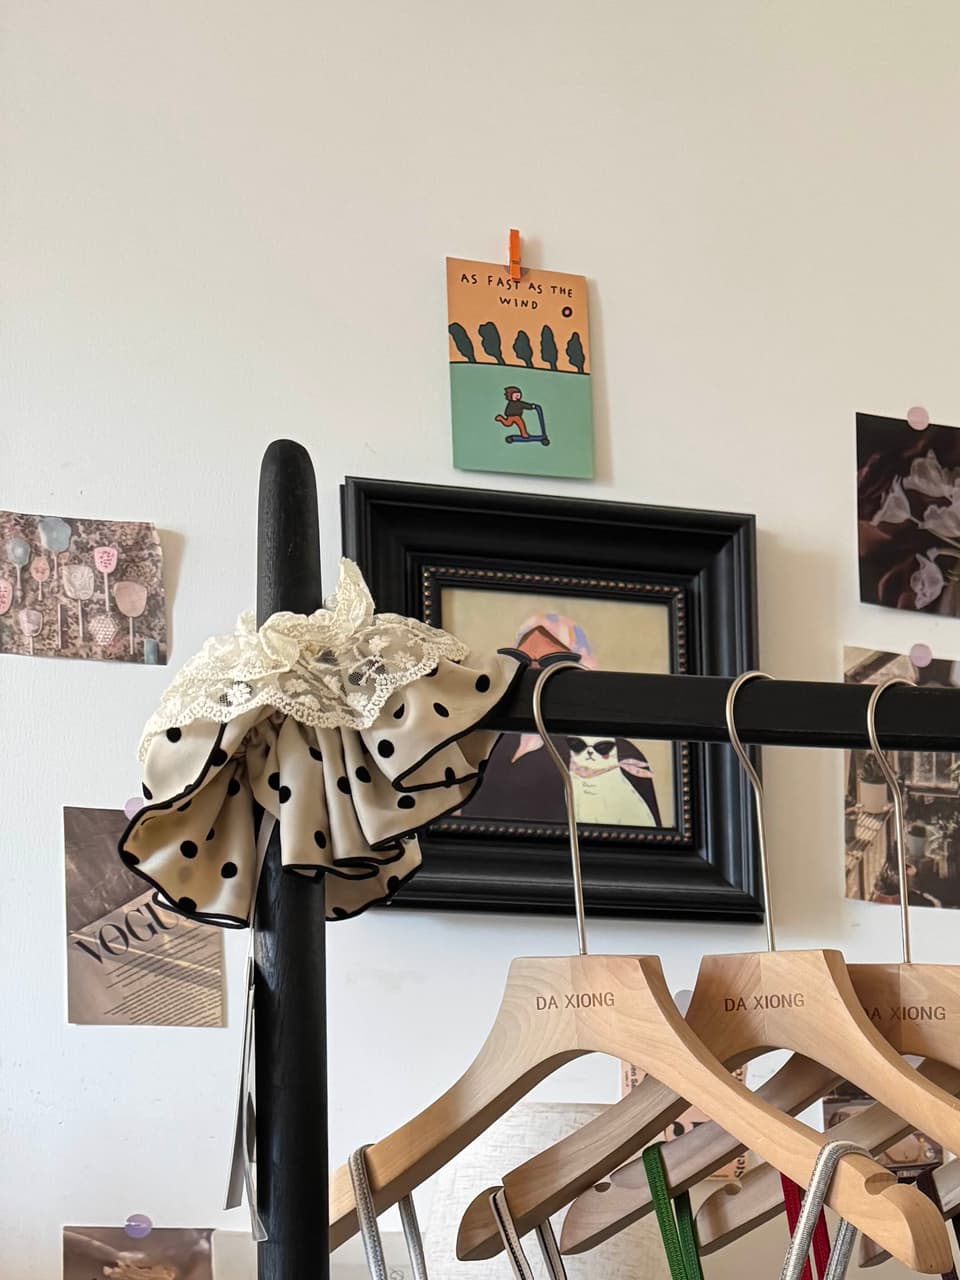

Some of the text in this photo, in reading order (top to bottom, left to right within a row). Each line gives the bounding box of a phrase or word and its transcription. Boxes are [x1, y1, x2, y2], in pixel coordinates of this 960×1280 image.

[461, 273, 573, 298] AS FAST AS THE
[499, 296, 538, 309] WIND
[74, 902, 179, 964] VOGU
[536, 992, 615, 1011] DA XIONG
[724, 993, 805, 1012] DA XIONG
[889, 1006, 946, 1021] XIONG
